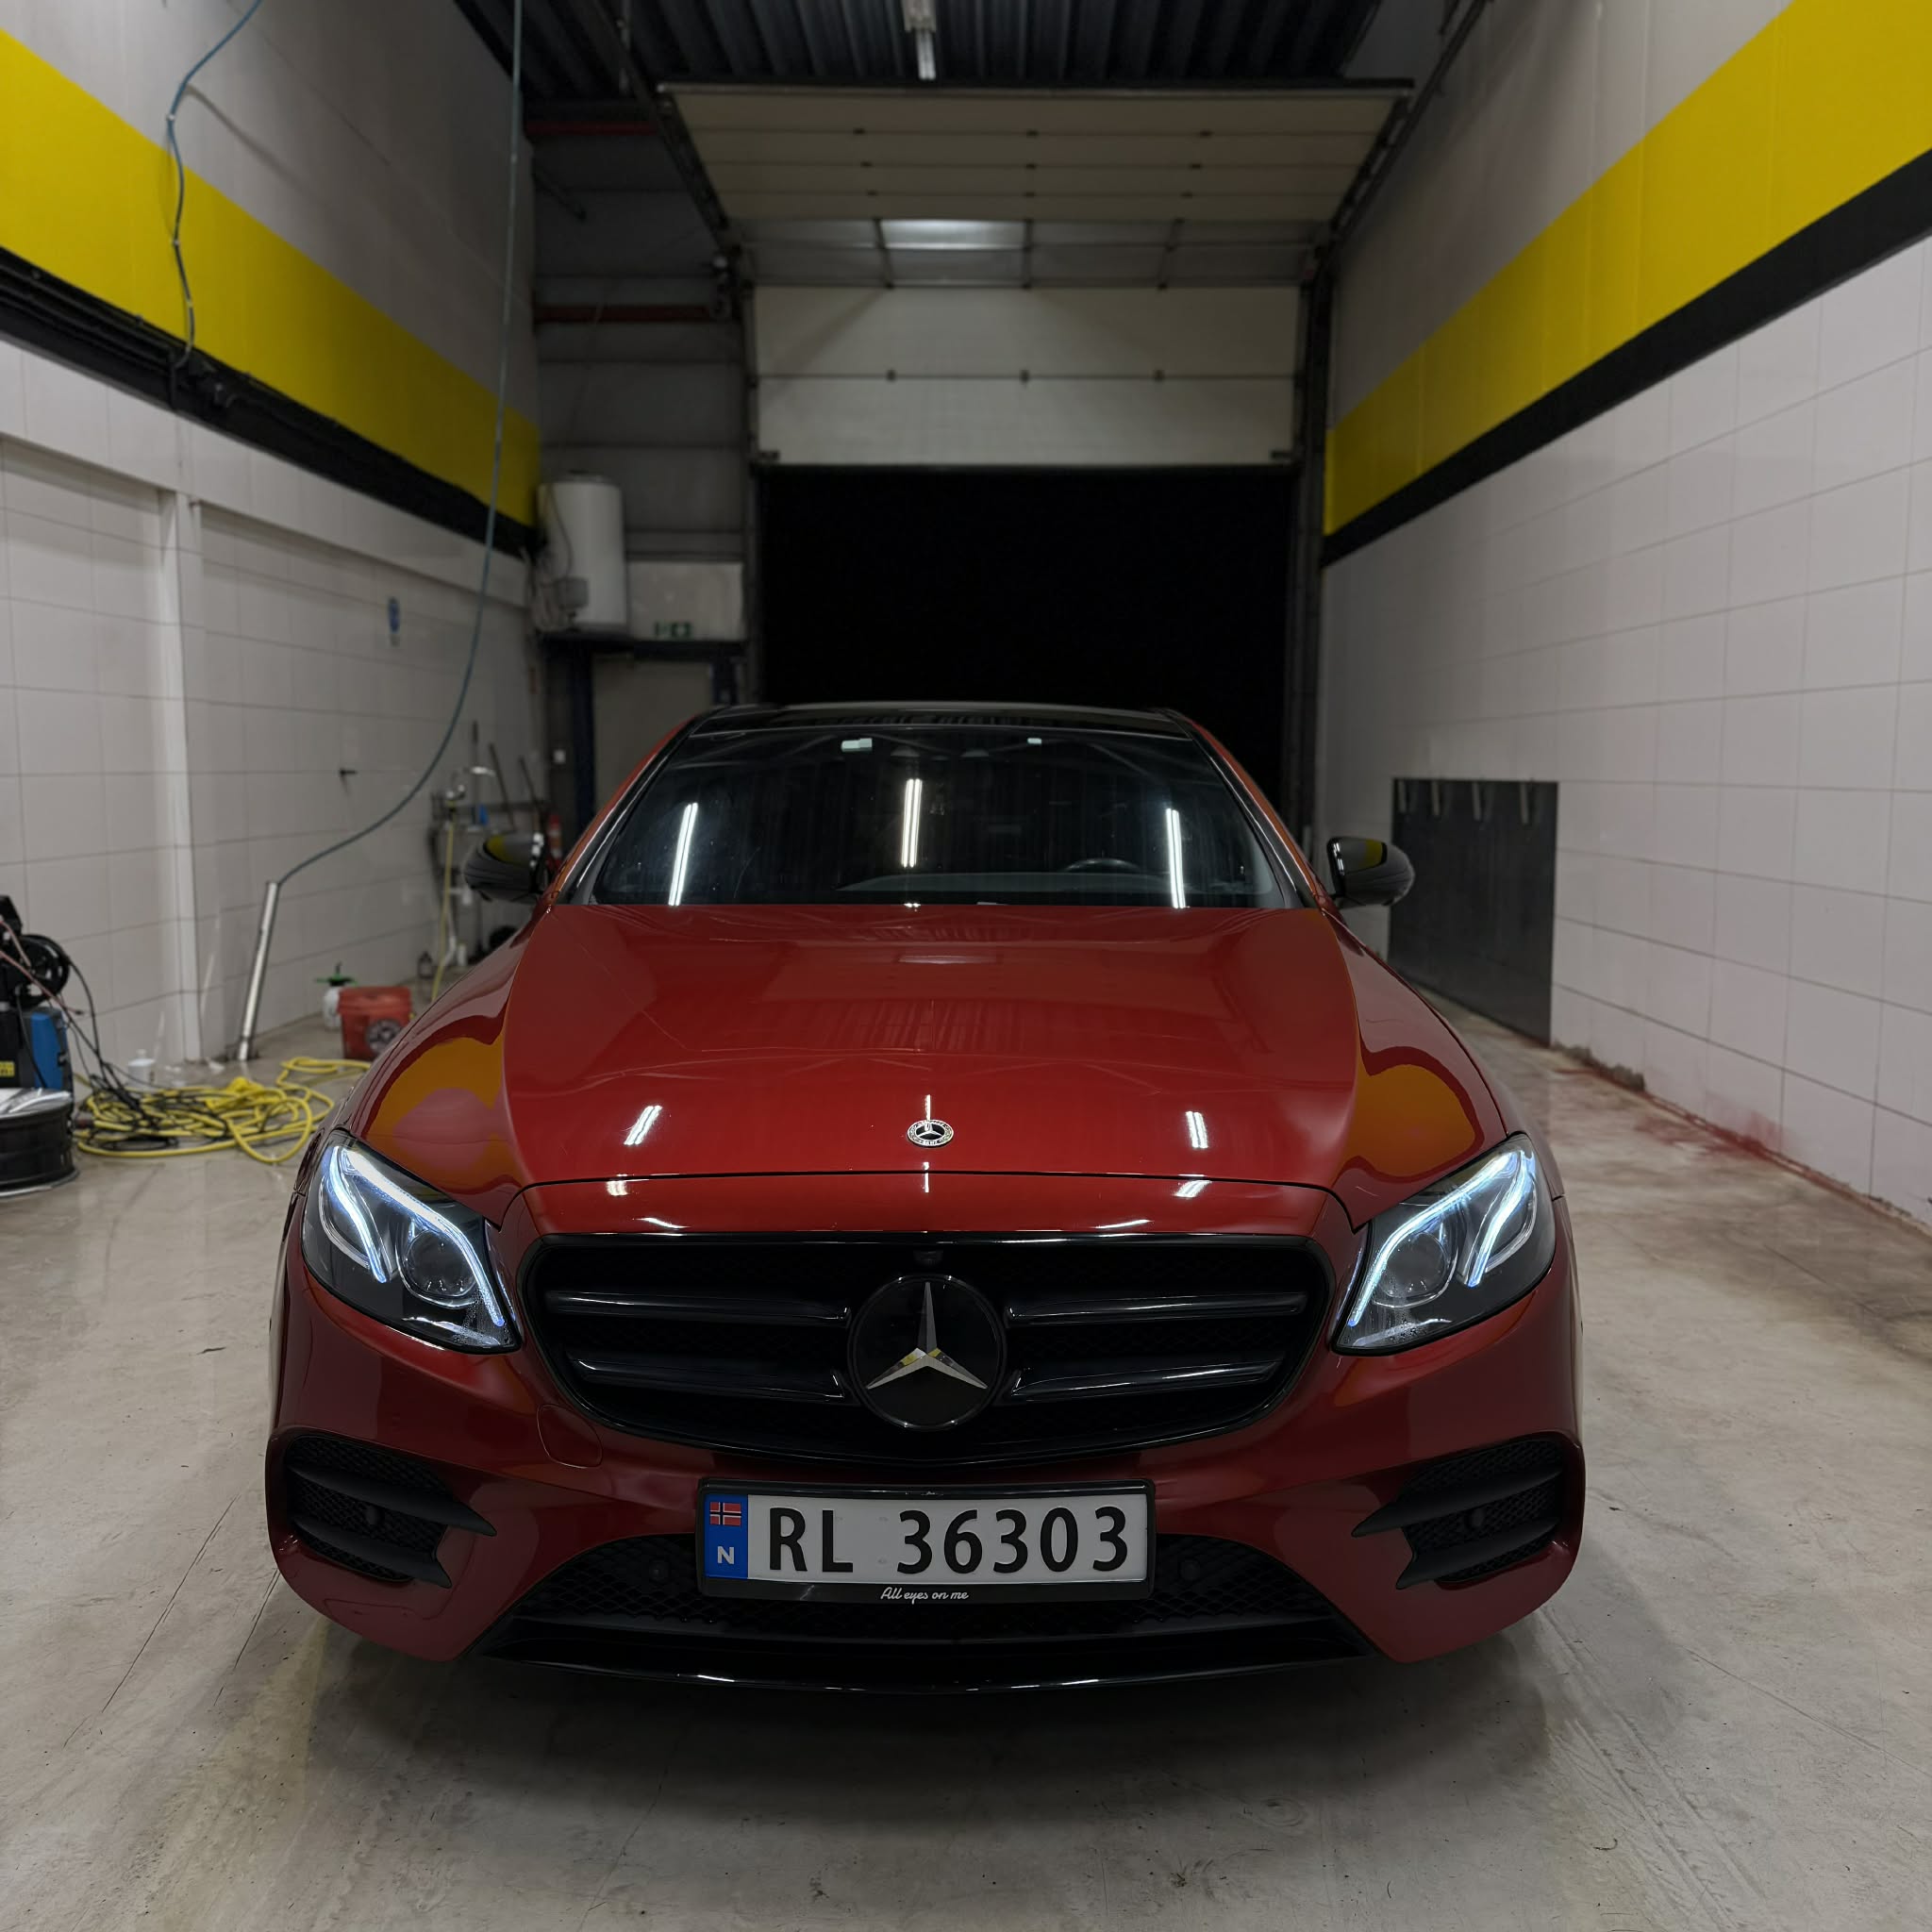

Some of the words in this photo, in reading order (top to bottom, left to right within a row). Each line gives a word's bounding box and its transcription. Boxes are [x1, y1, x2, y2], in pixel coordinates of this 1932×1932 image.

[769, 1507, 854, 1573] RL
[896, 1506, 1128, 1574] 36303
[717, 1545, 735, 1565] N
[880, 1586, 903, 1600] All
[904, 1591, 929, 1605] eyes
[931, 1591, 949, 1600] on
[950, 1591, 969, 1600] me
